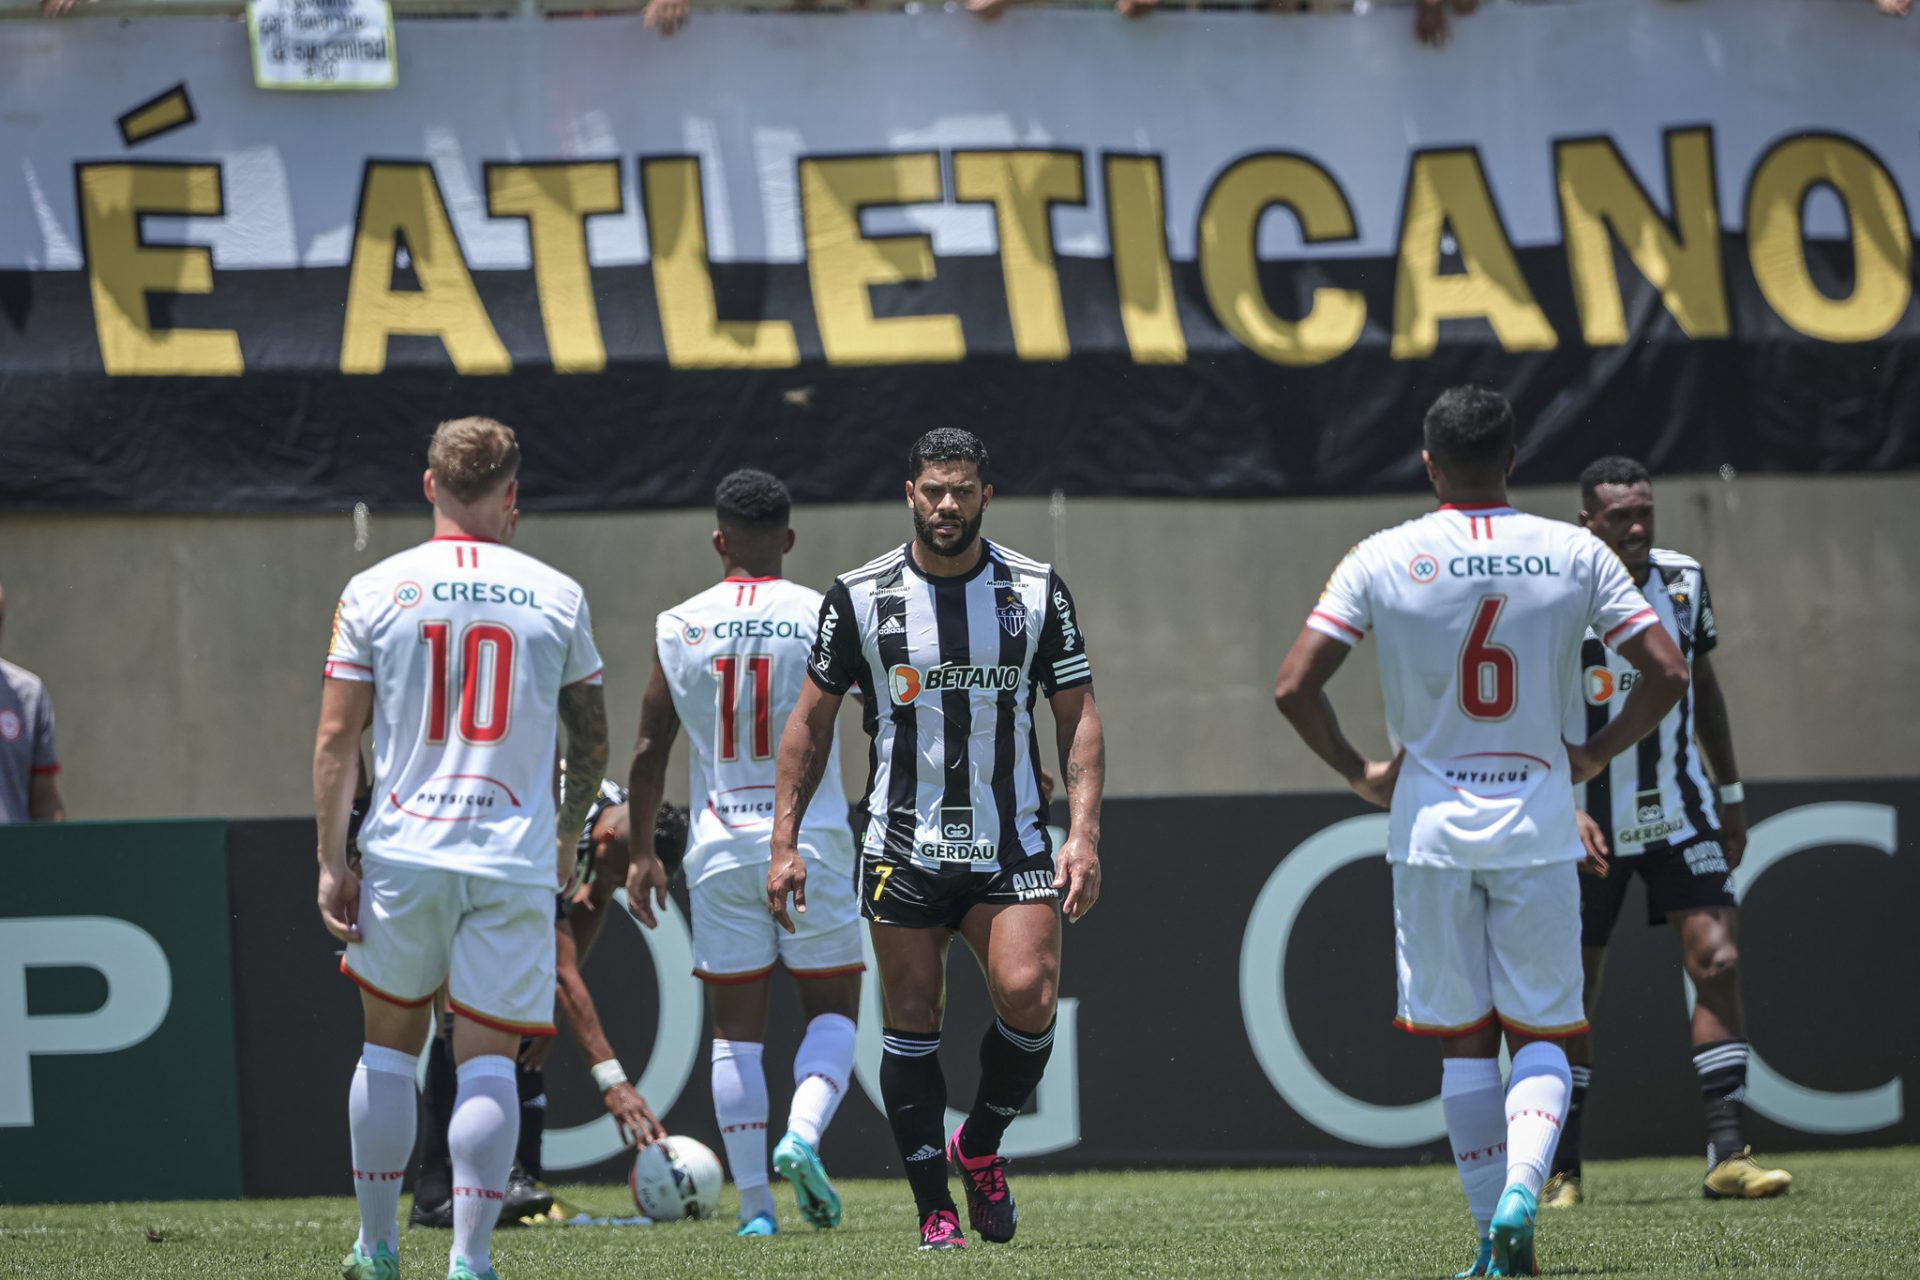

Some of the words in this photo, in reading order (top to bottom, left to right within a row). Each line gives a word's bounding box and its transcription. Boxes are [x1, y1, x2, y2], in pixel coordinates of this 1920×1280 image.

[75, 82, 244, 376] É
[340, 122, 1913, 374] ATLETICANO
[1450, 555, 1560, 577] CRESOL
[432, 582, 542, 609] CRESOL
[714, 620, 806, 639] CRESOL
[821, 604, 839, 652] MRV
[879, 626, 905, 635] adidas
[1457, 593, 1518, 723] 6
[419, 619, 517, 747] 10
[924, 665, 1020, 691] BETANO
[711, 654, 773, 762] 11
[1446, 769, 1528, 783] PHYSICUS
[417, 792, 495, 808] PHYSICUS
[717, 802, 773, 813] HYSICU
[921, 842, 996, 862] GERDAU
[874, 865, 893, 901] 7
[1012, 870, 1055, 891] AUTO
[0, 916, 172, 1127] P
